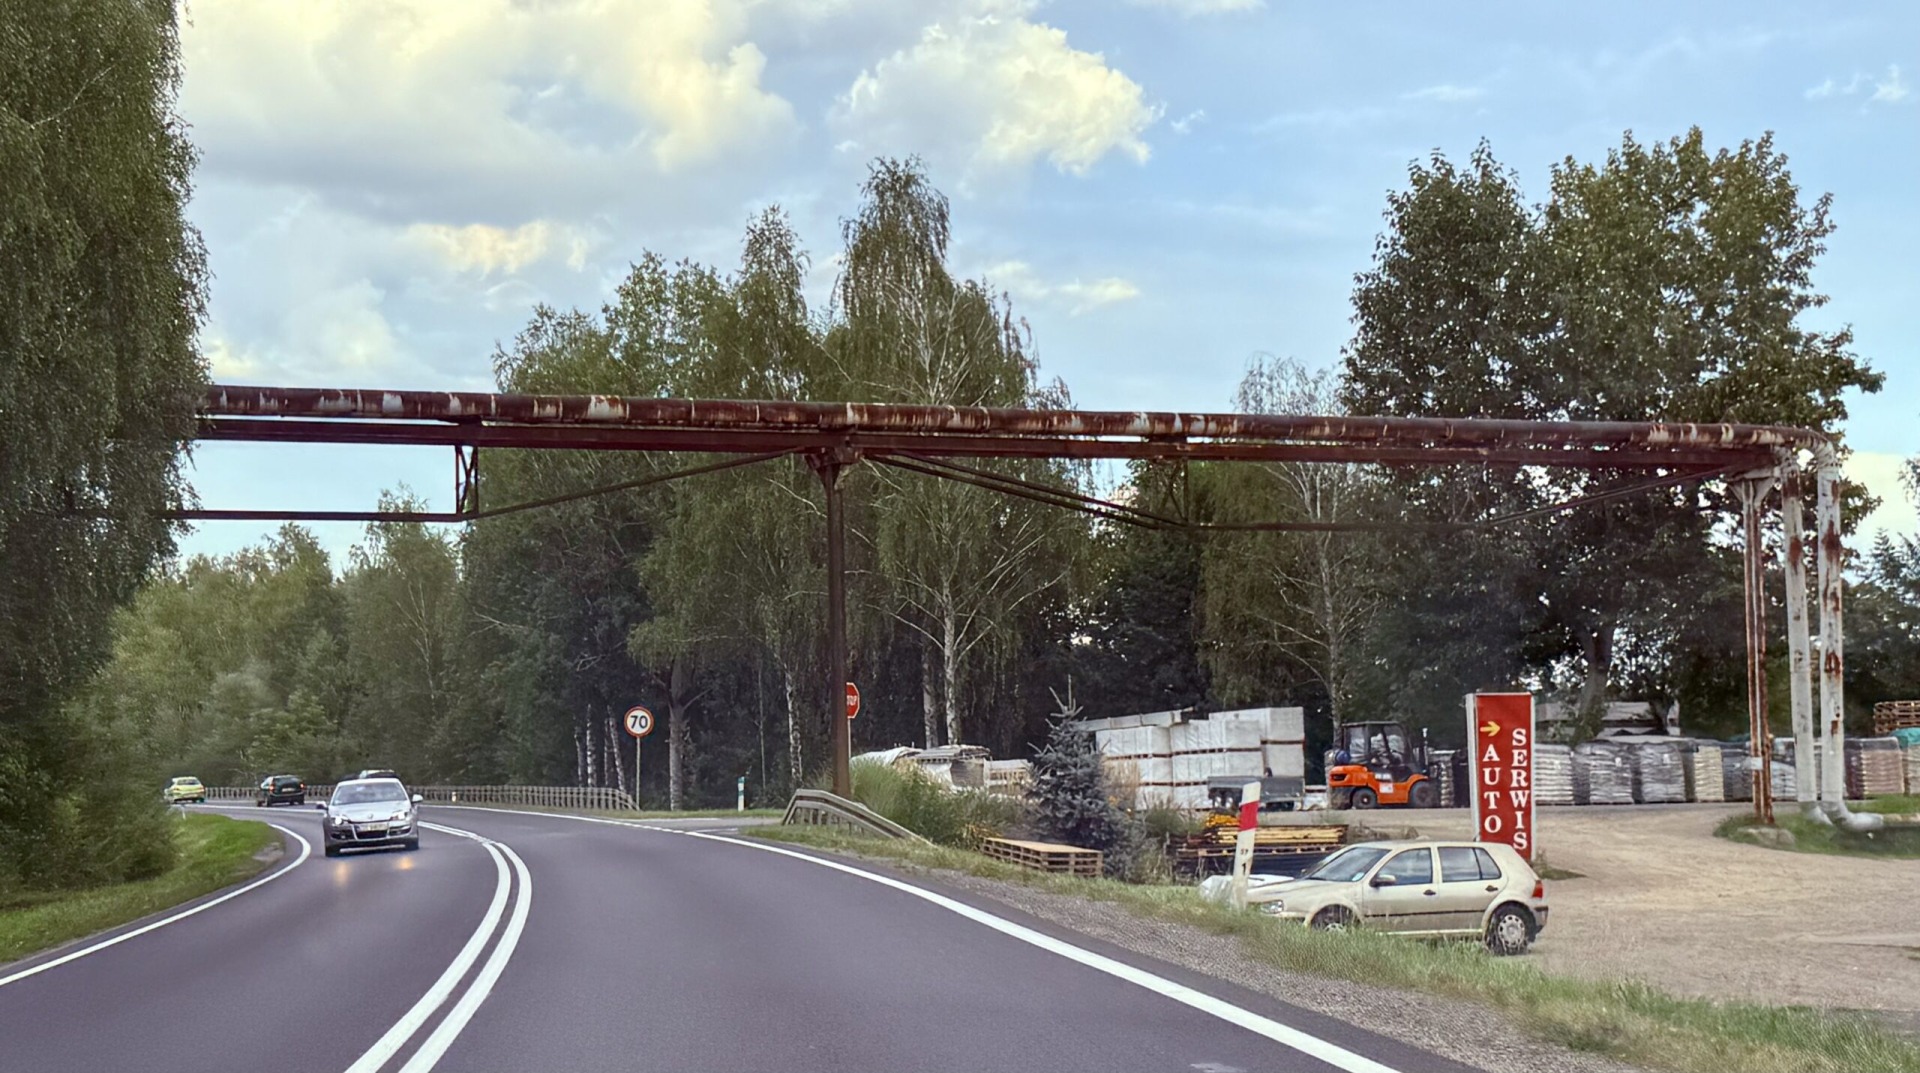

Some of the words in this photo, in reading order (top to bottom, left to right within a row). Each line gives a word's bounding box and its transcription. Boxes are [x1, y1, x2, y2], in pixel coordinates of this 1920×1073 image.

[630, 715, 648, 729] 70
[1483, 744, 1502, 833] AUTO
[1510, 728, 1530, 850] SERWIS
